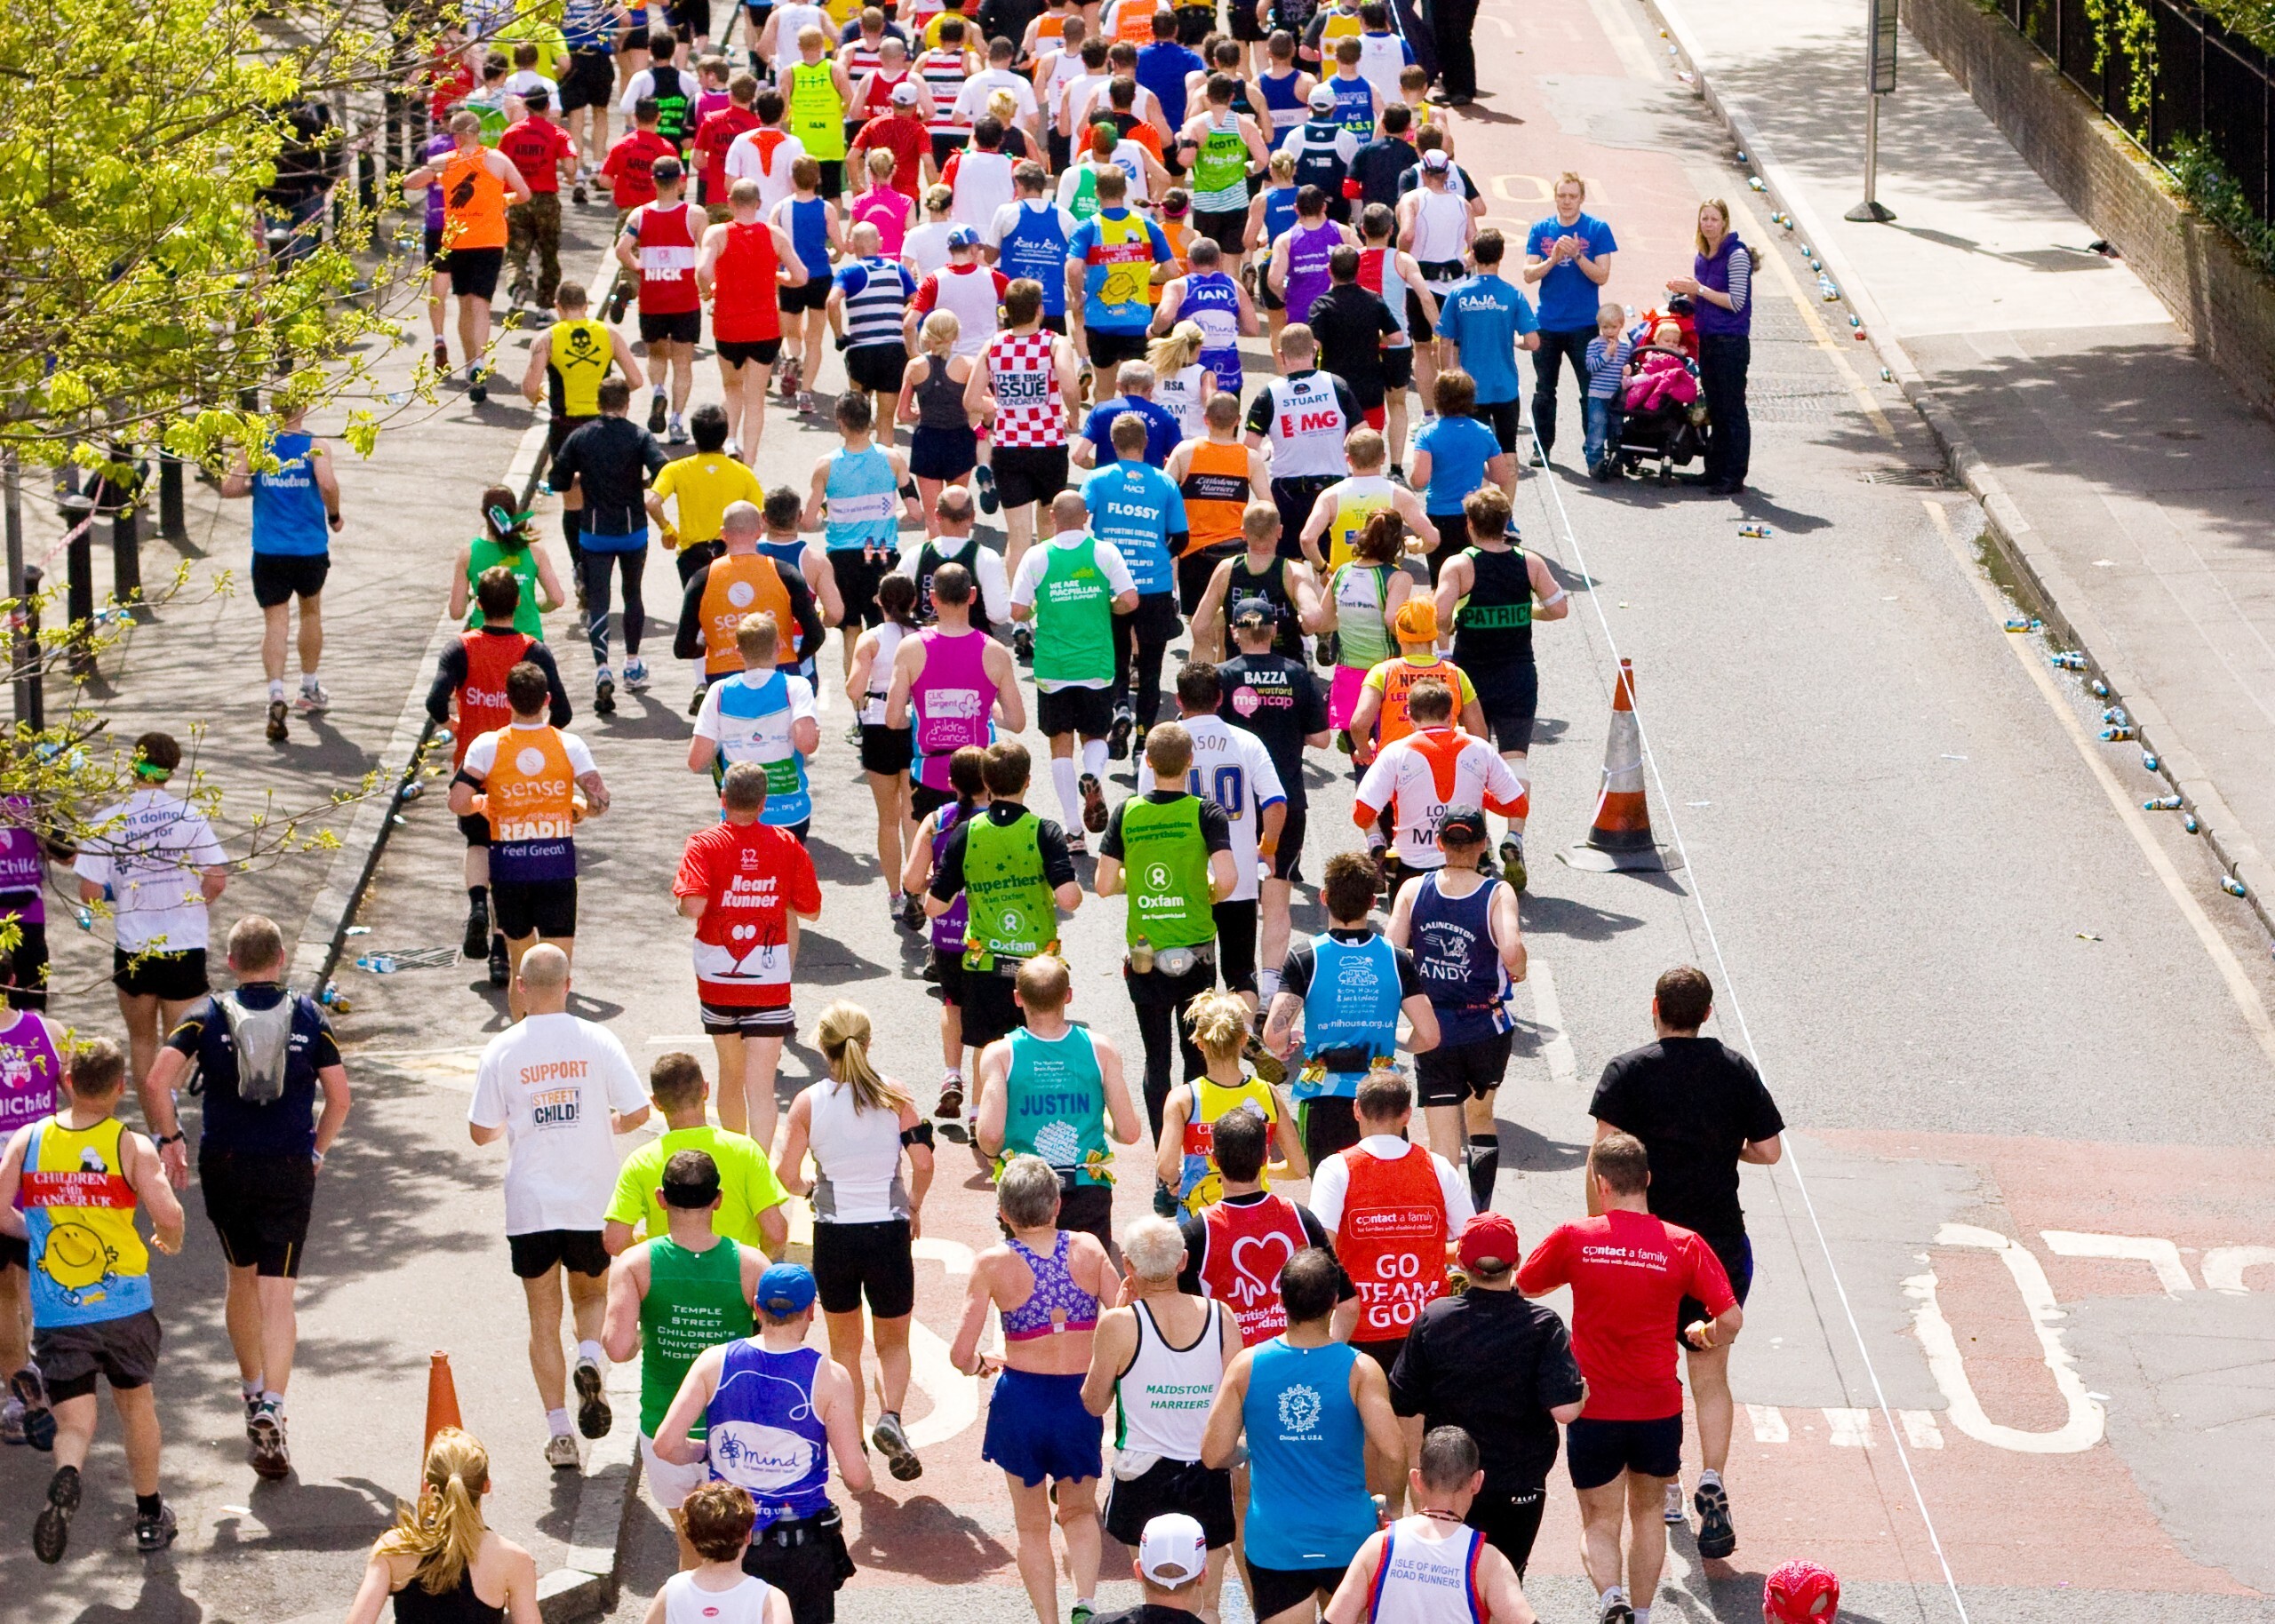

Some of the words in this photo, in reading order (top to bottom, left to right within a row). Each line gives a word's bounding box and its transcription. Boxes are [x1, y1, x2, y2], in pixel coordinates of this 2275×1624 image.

[644, 268, 682, 282] NICK
[1197, 290, 1229, 301] IAN
[1458, 294, 1497, 309] RAJA
[995, 373, 1021, 383] THE
[1024, 372, 1046, 383] BIG
[995, 381, 1047, 397] ISSUE
[1163, 381, 1185, 392] RSA
[1282, 393, 1329, 407] STUART
[1107, 502, 1160, 521] FLOSSY
[1064, 579, 1080, 588] ARE
[1244, 671, 1288, 685] BAZZA
[1257, 687, 1293, 697] watford
[928, 700, 958, 709] Sargent
[1233, 695, 1294, 710] mencap
[938, 735, 970, 744] cancer
[499, 779, 567, 800] sense
[502, 844, 527, 856] Feel
[529, 844, 565, 856] Great!
[730, 874, 777, 892] Heart
[721, 890, 779, 908] Runner
[1137, 895, 1185, 909] Oxfam
[1419, 921, 1477, 943] LAUNCESTON
[988, 939, 1037, 952] Oxfam
[1419, 962, 1473, 983] ANDY
[520, 1060, 588, 1085] SUPPORT
[1020, 1092, 1090, 1117] JUSTIN
[34, 1172, 108, 1186] CHILDREN
[59, 1183, 83, 1195] with
[33, 1194, 88, 1206] CANCER
[91, 1196, 112, 1207] UK
[1355, 1213, 1397, 1226] contact
[1399, 1214, 1406, 1222] a
[1408, 1210, 1434, 1223] family
[1582, 1245, 1626, 1257] contact
[1628, 1249, 1635, 1258] a
[1637, 1247, 1668, 1266] family
[1376, 1253, 1420, 1279] GO
[1646, 1262, 1667, 1272] children
[1355, 1280, 1440, 1303] TEAM
[672, 1304, 722, 1316] TEMPLE
[671, 1317, 723, 1326] STREET
[657, 1325, 737, 1339] CHILDREN'S
[1145, 1383, 1214, 1395] MAIDSTONE
[1150, 1399, 1210, 1410] HARRIERS
[744, 1448, 800, 1467] mind
[1394, 1558, 1415, 1570] ISLE
[1416, 1561, 1430, 1572] OF
[1430, 1564, 1460, 1578] WIGHT
[1389, 1568, 1417, 1581] ROAD
[1417, 1572, 1461, 1589] RUNNERS
